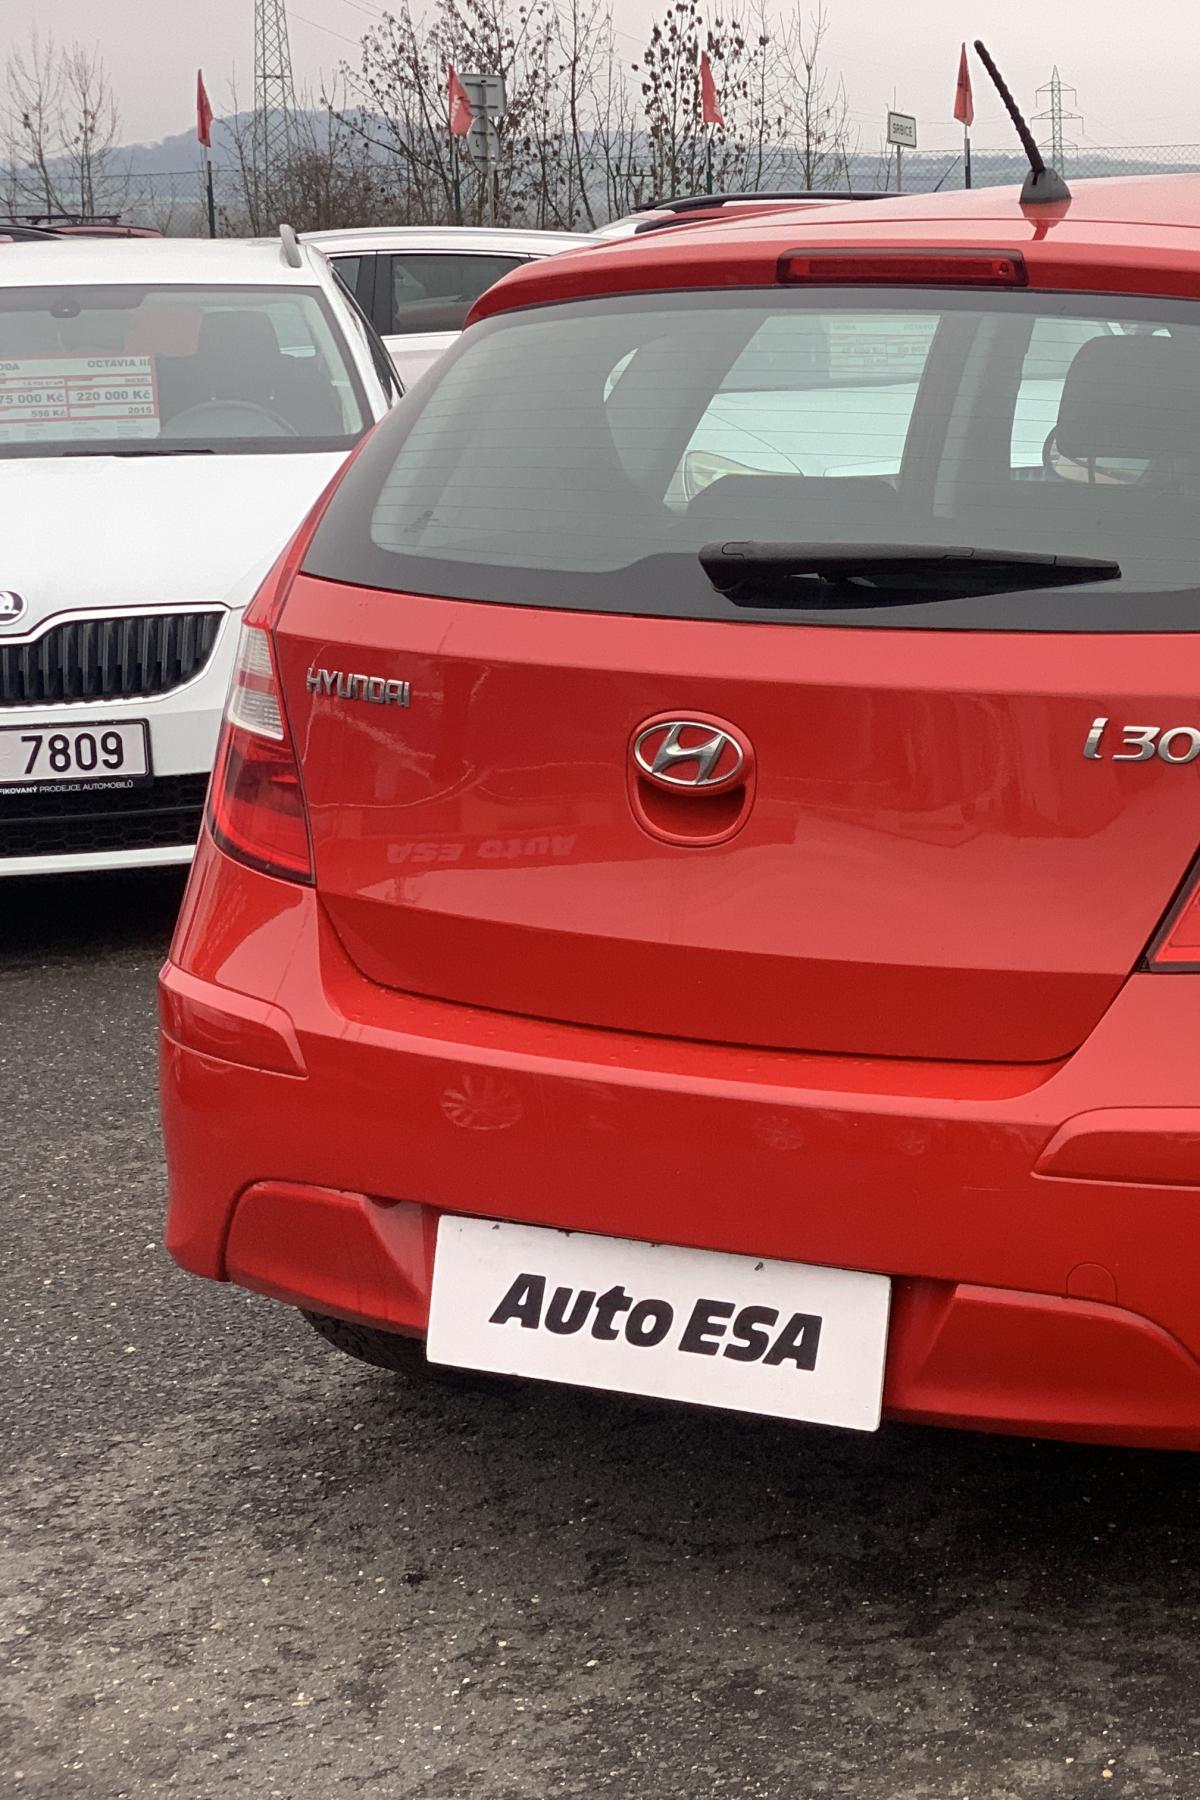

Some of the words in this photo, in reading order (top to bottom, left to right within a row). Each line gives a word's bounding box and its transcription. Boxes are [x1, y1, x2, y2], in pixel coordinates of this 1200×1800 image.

[87, 359, 136, 368] OCTAVIA
[17, 394, 42, 404] 000
[46, 392, 65, 403] Kč
[76, 392, 100, 402] 220
[105, 391, 129, 400] 000
[133, 389, 151, 399] Kč
[306, 667, 410, 707] HYUNDAI
[21, 731, 124, 774] 7809
[40, 784, 81, 793] PRODEJCE
[488, 1273, 674, 1347] Auto
[678, 1298, 823, 1371] ESA
